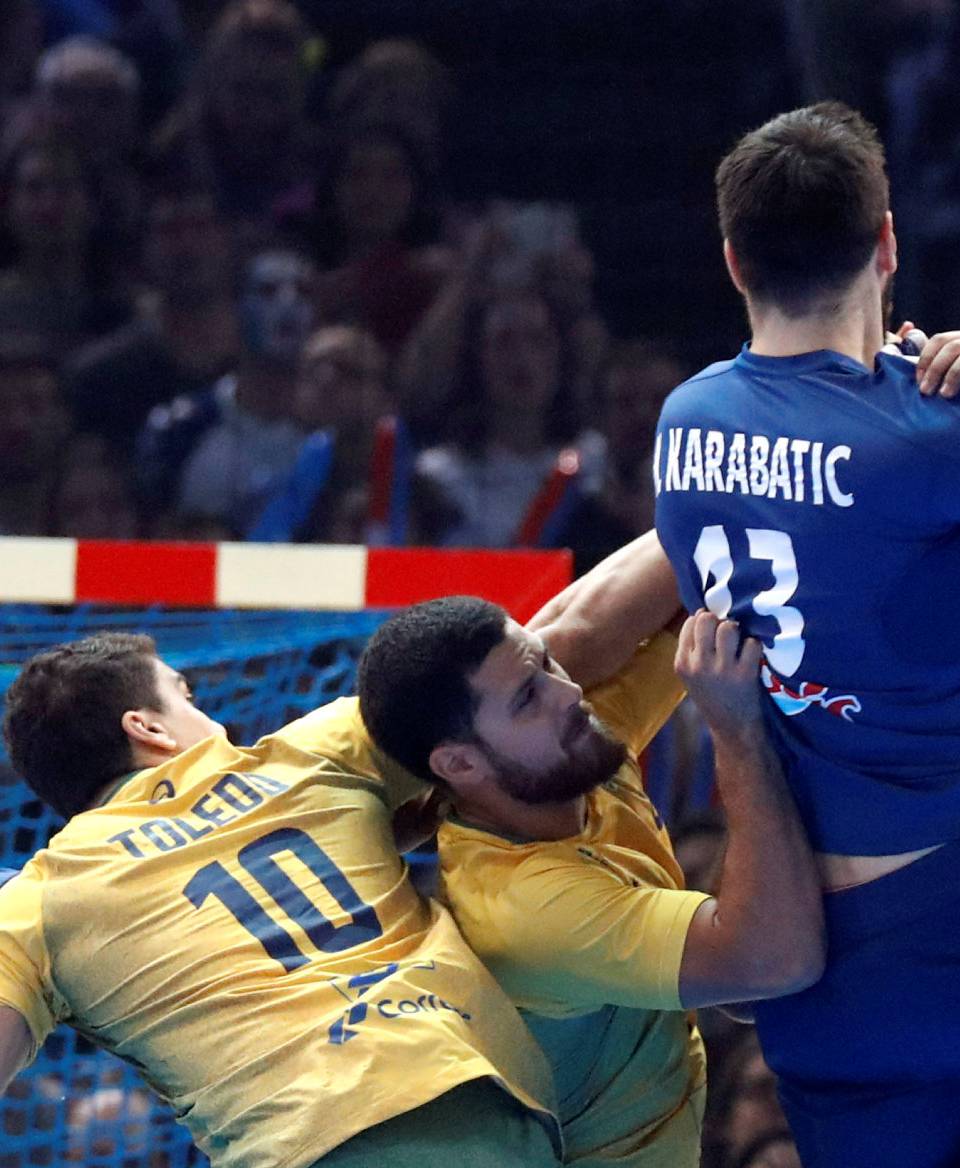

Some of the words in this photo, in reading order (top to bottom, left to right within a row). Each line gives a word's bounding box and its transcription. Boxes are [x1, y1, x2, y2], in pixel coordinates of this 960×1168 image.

[665, 427, 855, 508] KARABATIC
[692, 524, 806, 679] 13
[182, 827, 383, 973] 10
